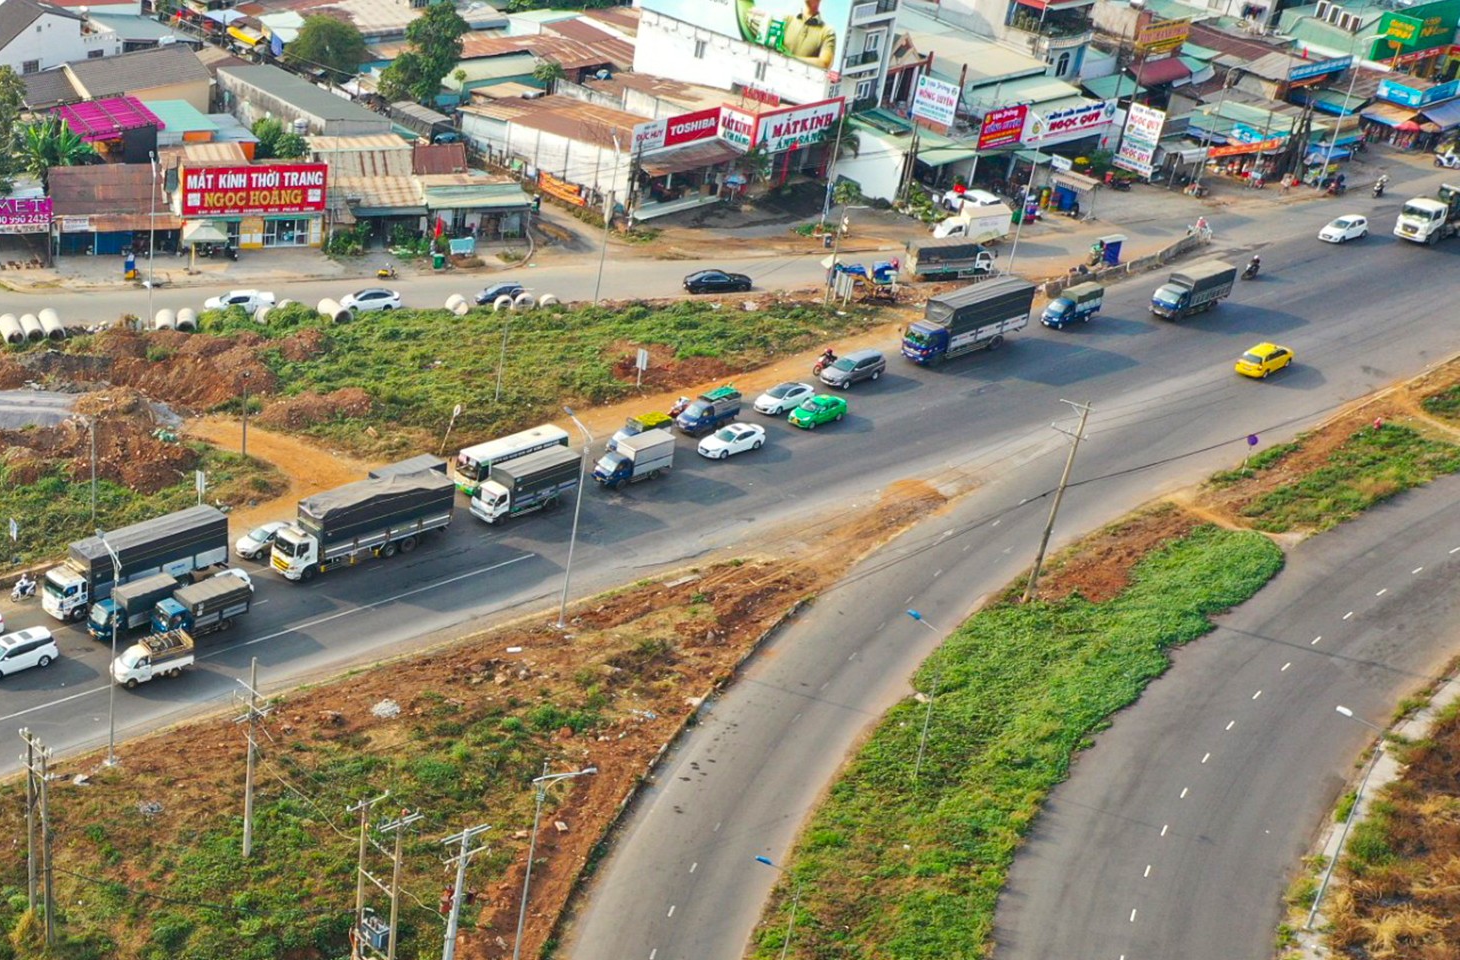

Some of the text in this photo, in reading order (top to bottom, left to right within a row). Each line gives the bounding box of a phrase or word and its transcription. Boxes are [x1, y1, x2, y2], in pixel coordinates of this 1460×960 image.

[670, 116, 716, 137] TOSHIBA
[187, 169, 323, 190] MẮT KÍNH THỜI TRANG
[203, 190, 247, 208] NGỌC
[28, 213, 50, 224] 2425
